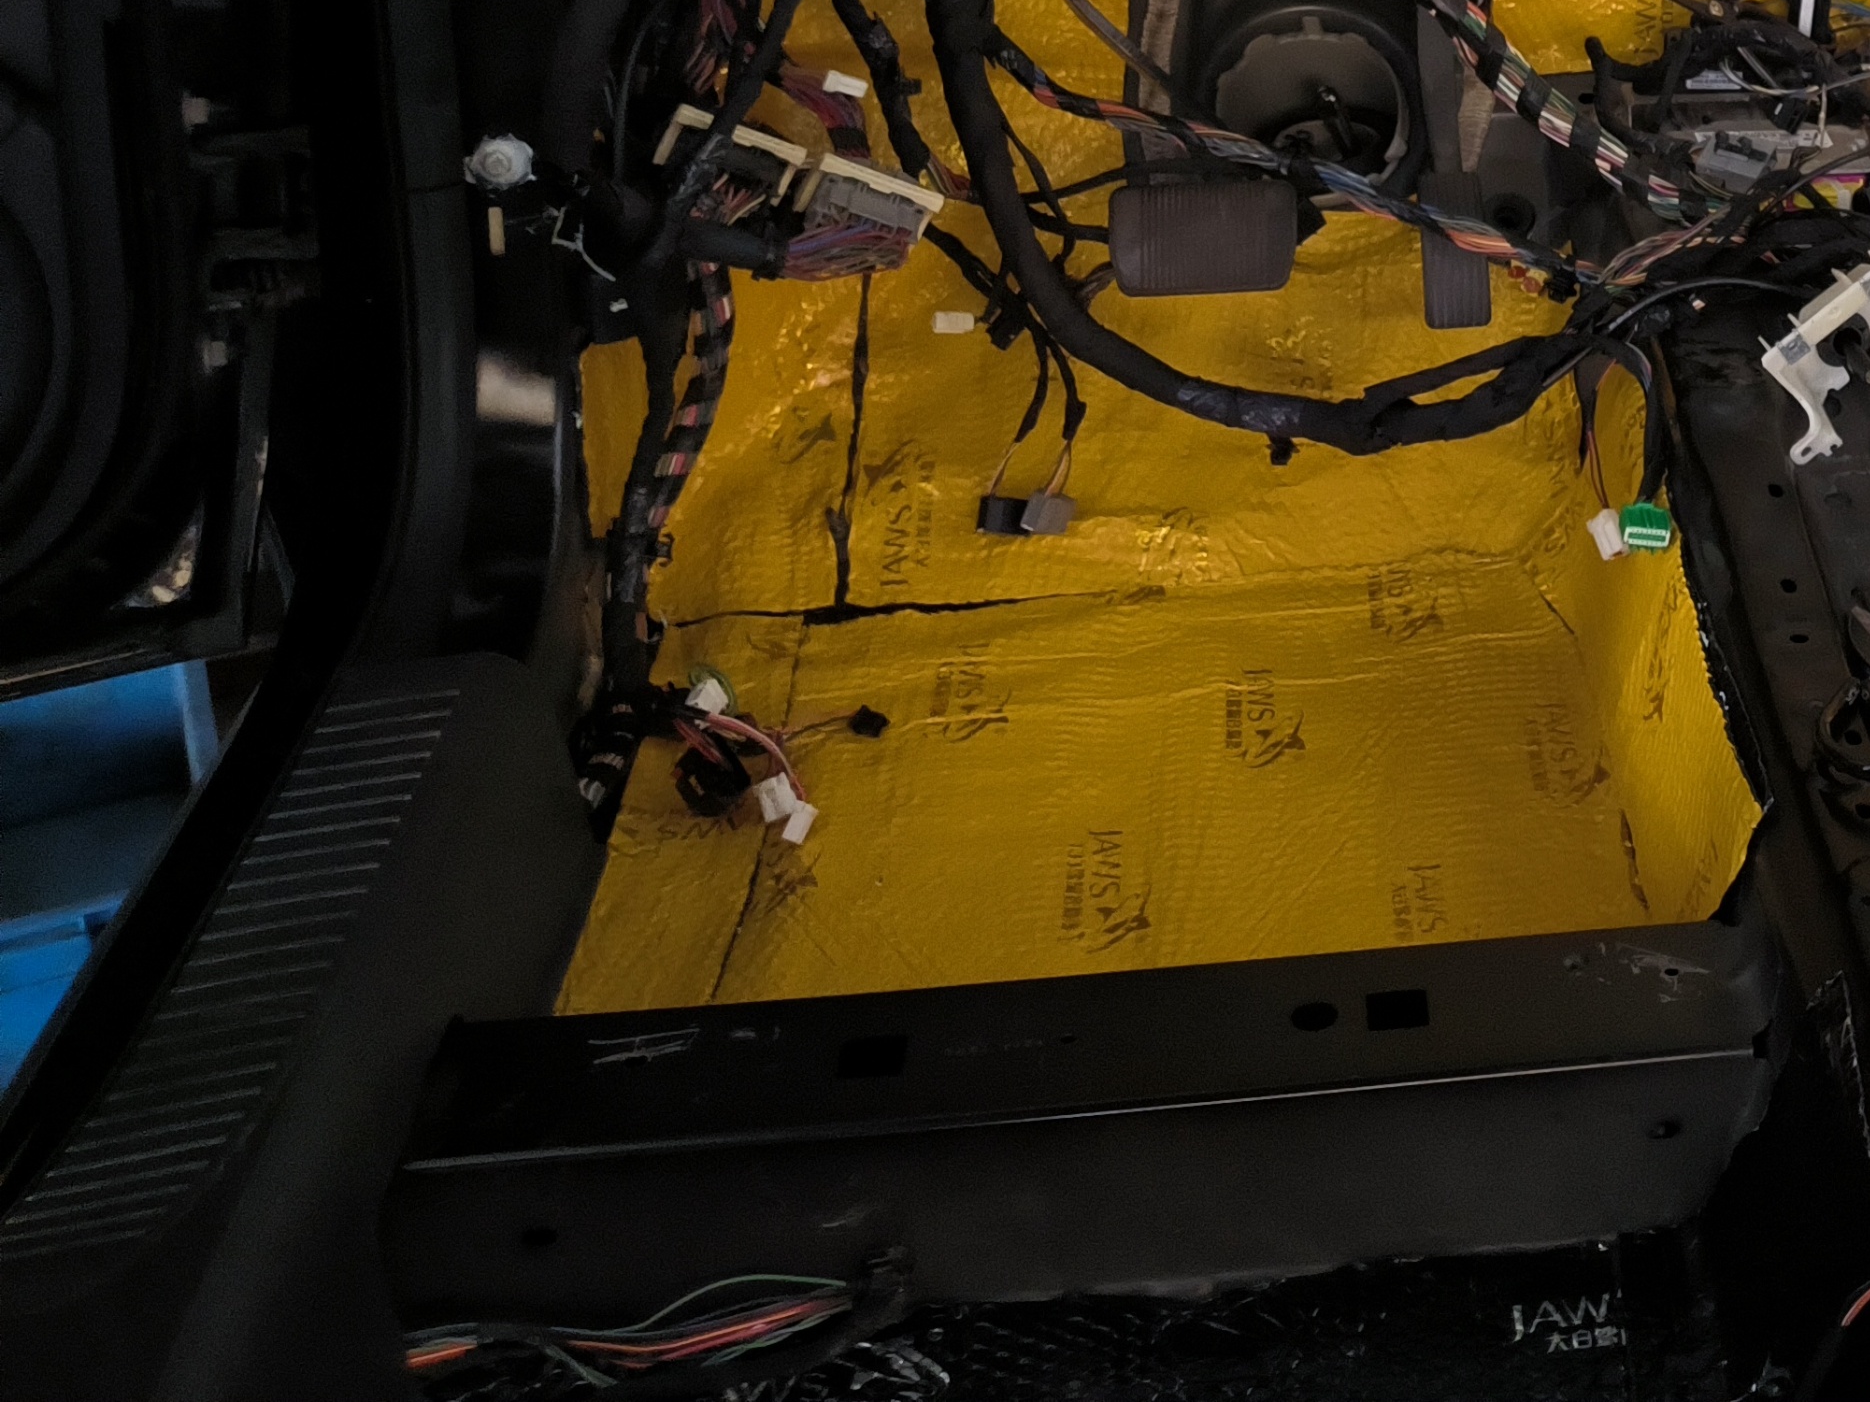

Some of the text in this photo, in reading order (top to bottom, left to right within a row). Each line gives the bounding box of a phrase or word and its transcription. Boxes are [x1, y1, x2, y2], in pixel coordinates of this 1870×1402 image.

[880, 503, 913, 588] JAWS
[1242, 669, 1276, 723] JAWS
[1089, 829, 1124, 900] JAWS
[1511, 1288, 1623, 1344] JAW
